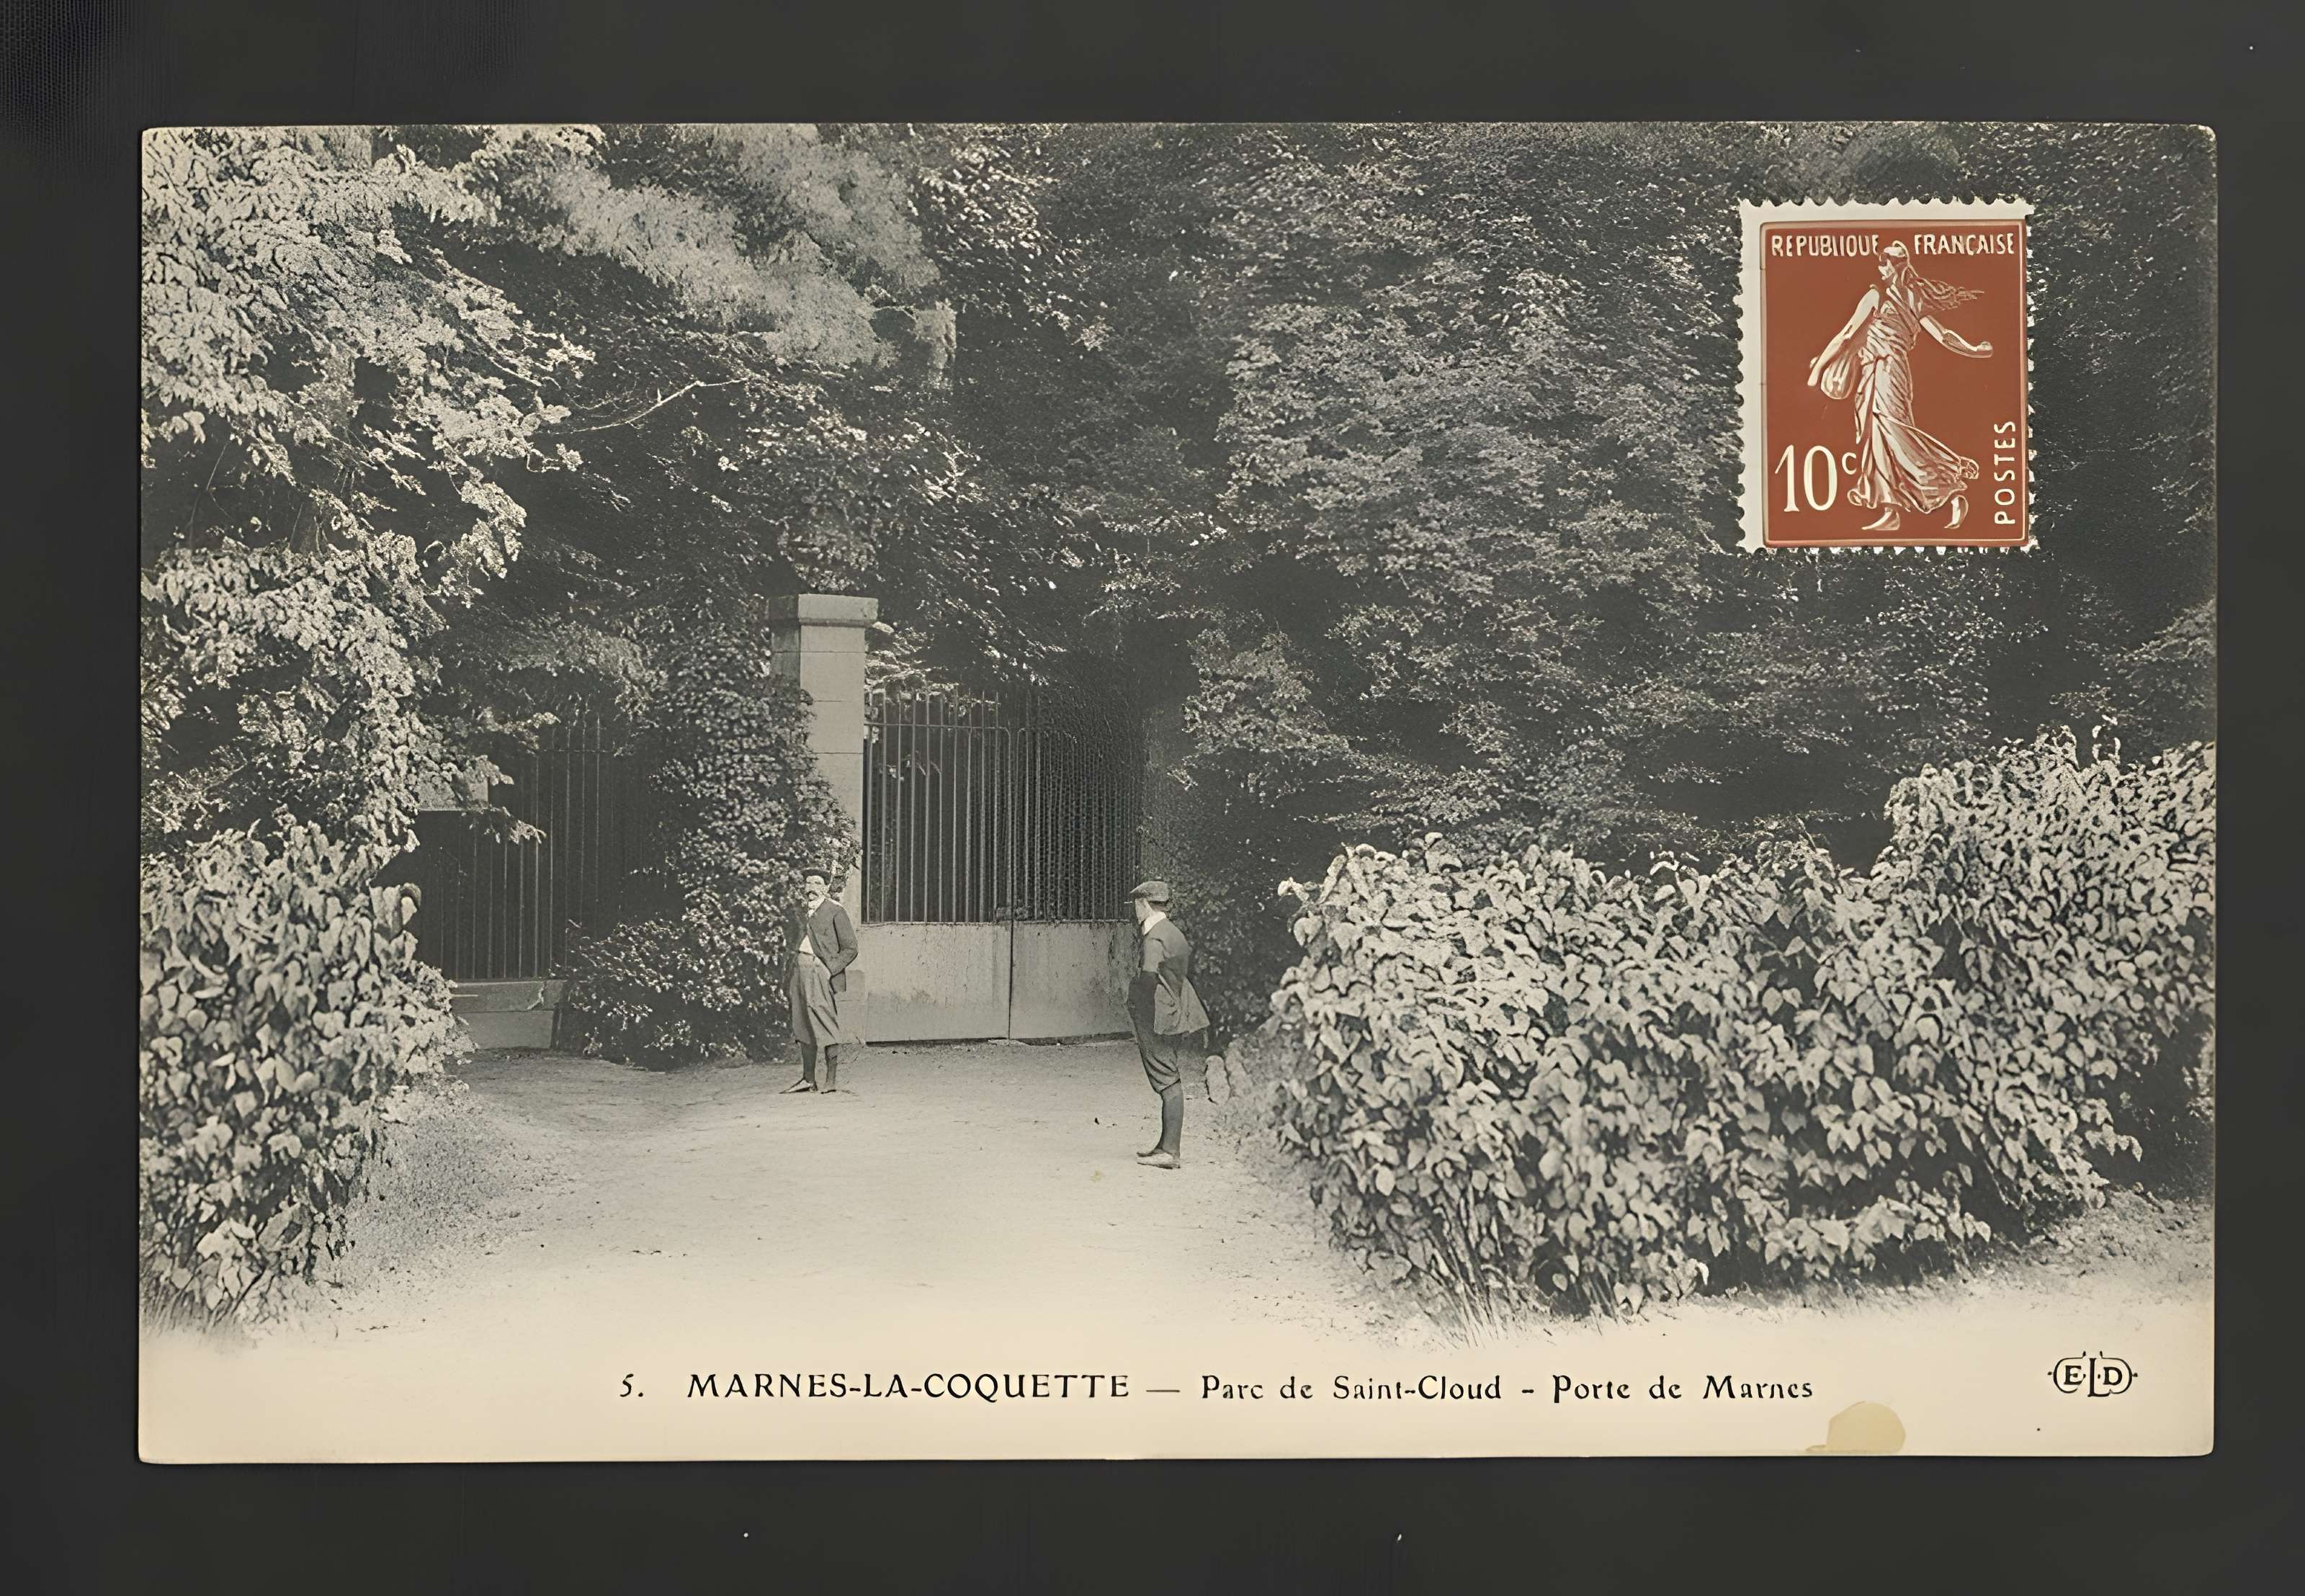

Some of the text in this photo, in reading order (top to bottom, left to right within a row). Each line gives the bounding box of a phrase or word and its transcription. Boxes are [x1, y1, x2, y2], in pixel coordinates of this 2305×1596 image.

[1914, 233, 2015, 256] FRANÇAISE
[1993, 421, 2016, 525] POSTES
[619, 1373, 644, 1398] 5.
[687, 1373, 1129, 1403] MARNES-LA-COQUETTE
[1201, 1375, 1263, 1399] Parc
[1279, 1376, 1313, 1399] de
[1333, 1375, 1501, 1400] Saint-Cloud
[1552, 1374, 1631, 1404] Porte
[1649, 1375, 1682, 1399] de
[1703, 1375, 1813, 1399] Marnes
